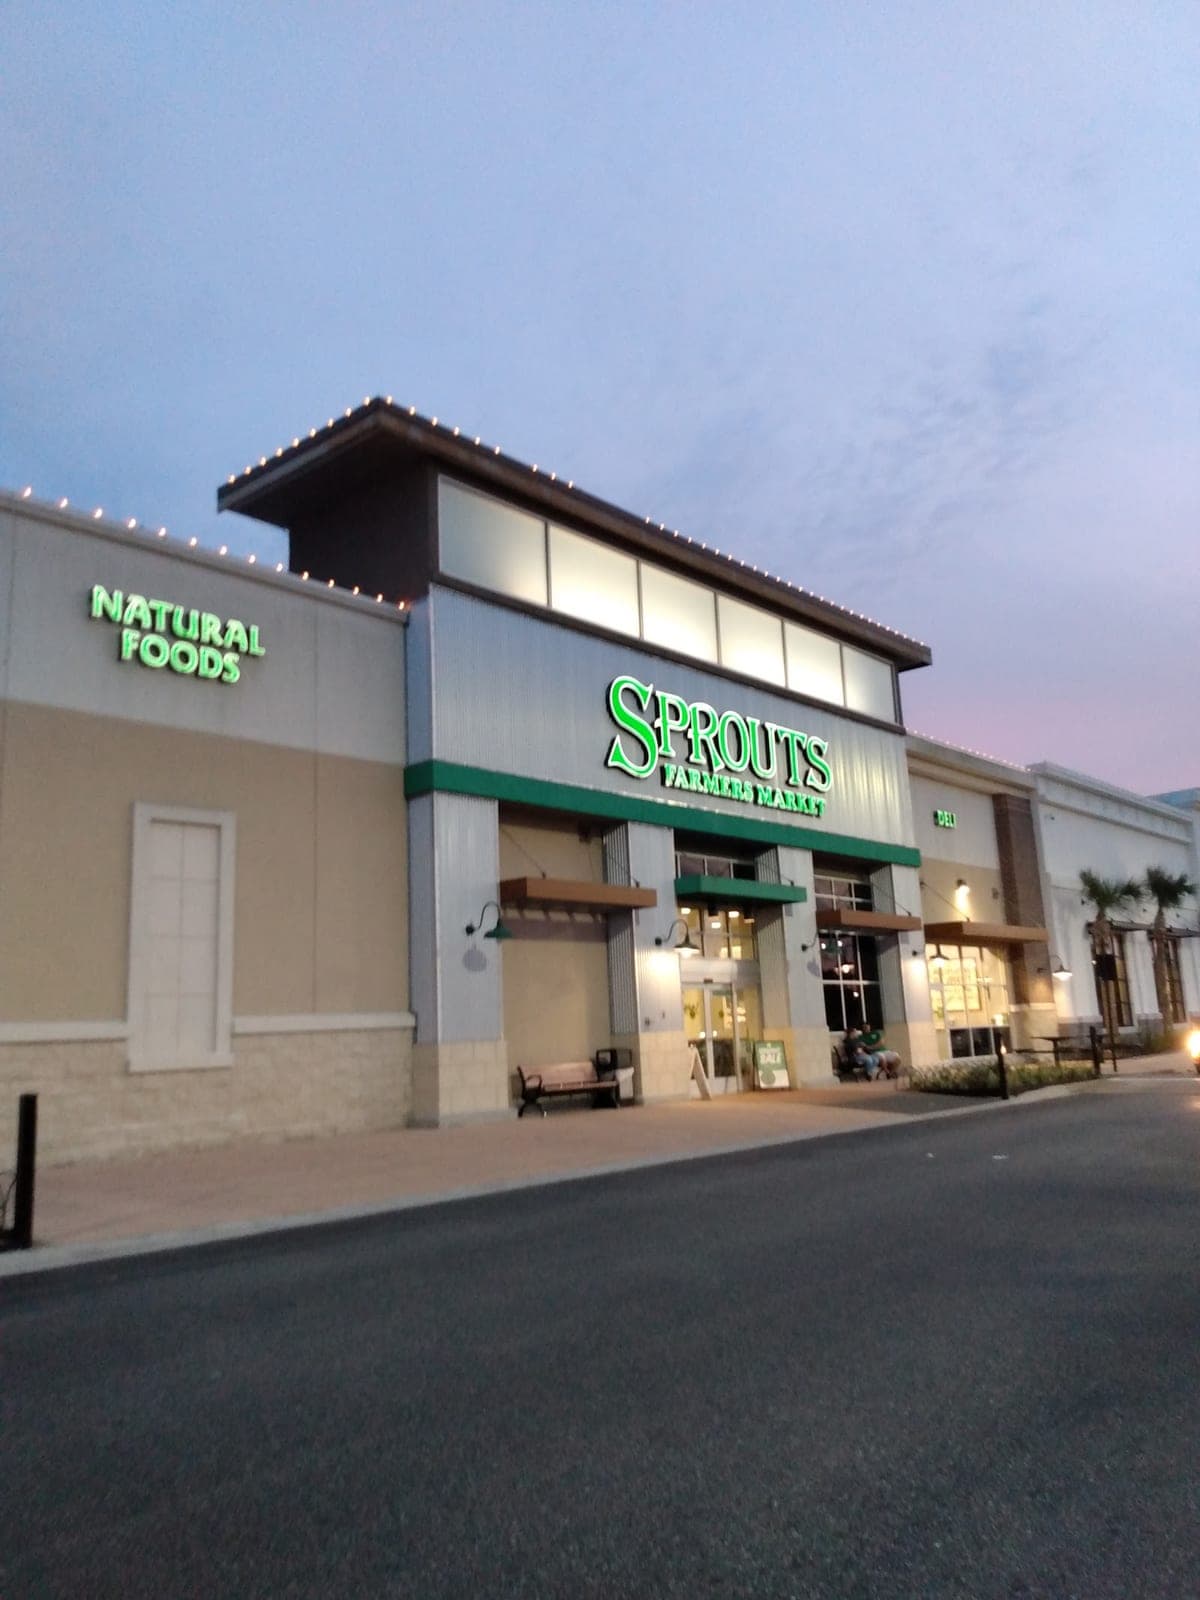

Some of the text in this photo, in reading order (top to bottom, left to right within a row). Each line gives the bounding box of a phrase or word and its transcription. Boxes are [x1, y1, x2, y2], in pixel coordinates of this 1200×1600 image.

[92, 584, 265, 656] NATURAL
[121, 628, 241, 683] FOODS
[608, 675, 833, 792] SPROUTS
[664, 763, 826, 817] FARMERS MARKET
